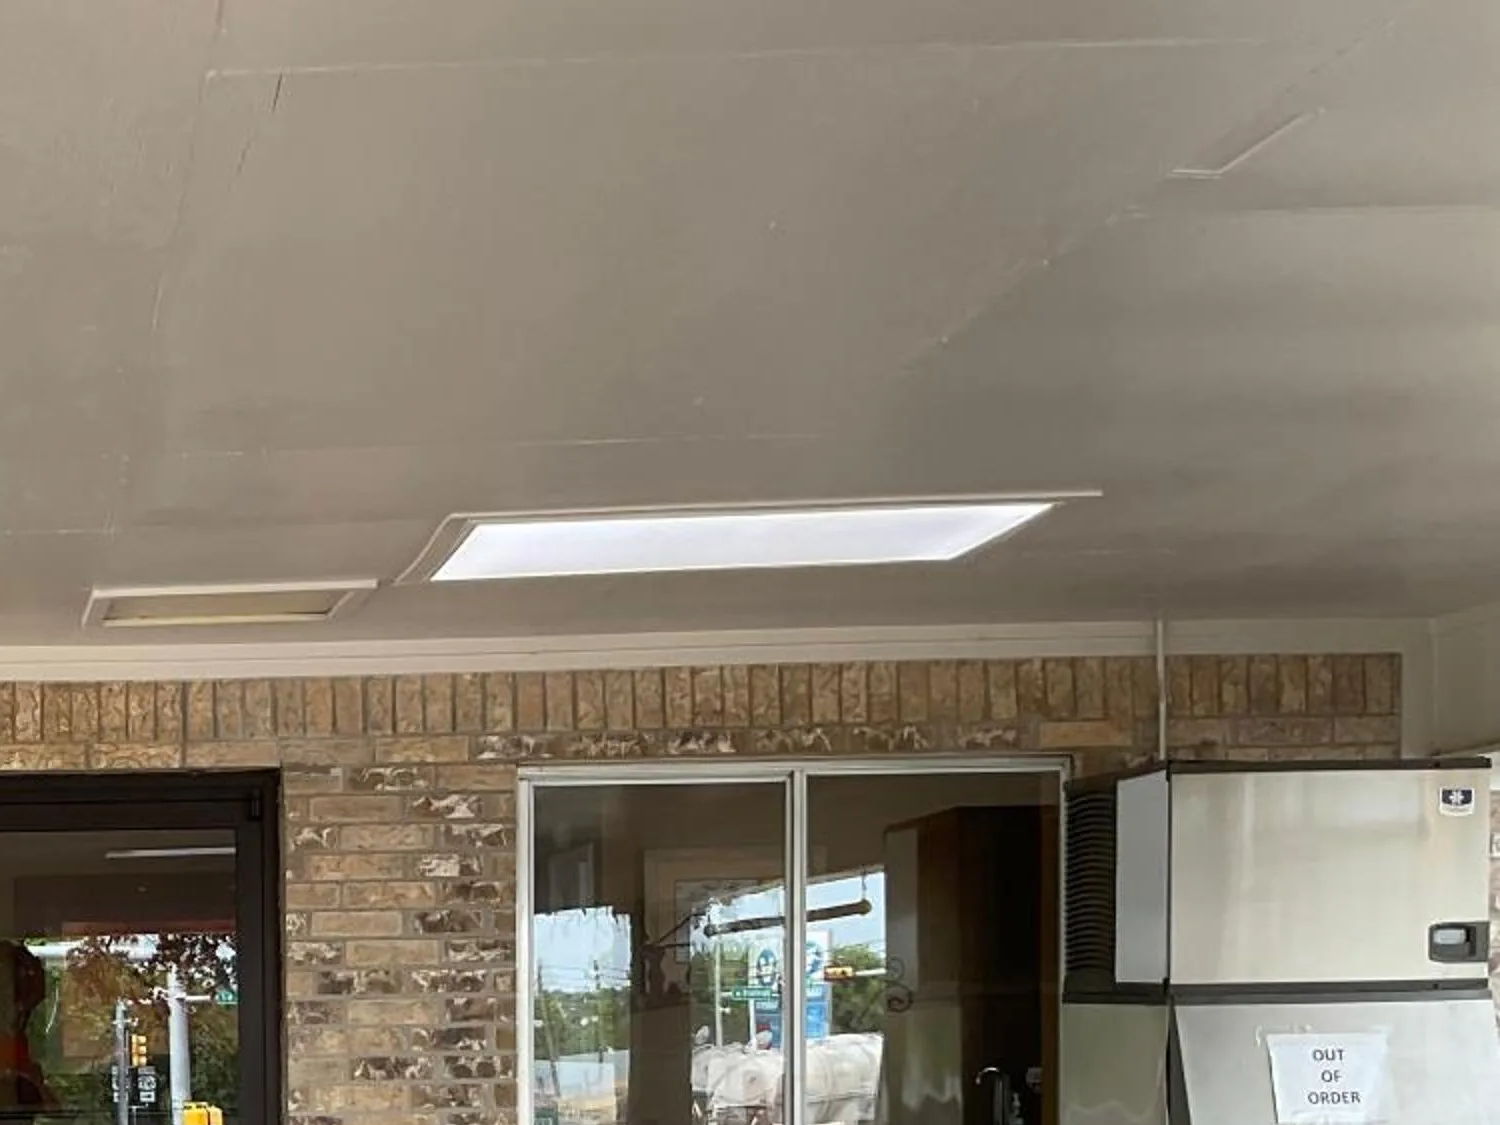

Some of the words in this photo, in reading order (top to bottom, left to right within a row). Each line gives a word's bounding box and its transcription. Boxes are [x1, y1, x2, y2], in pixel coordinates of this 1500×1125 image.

[1312, 1049, 1345, 1062] OUT
[1321, 1069, 1343, 1083] OF
[1307, 1091, 1362, 1105] ORDER
